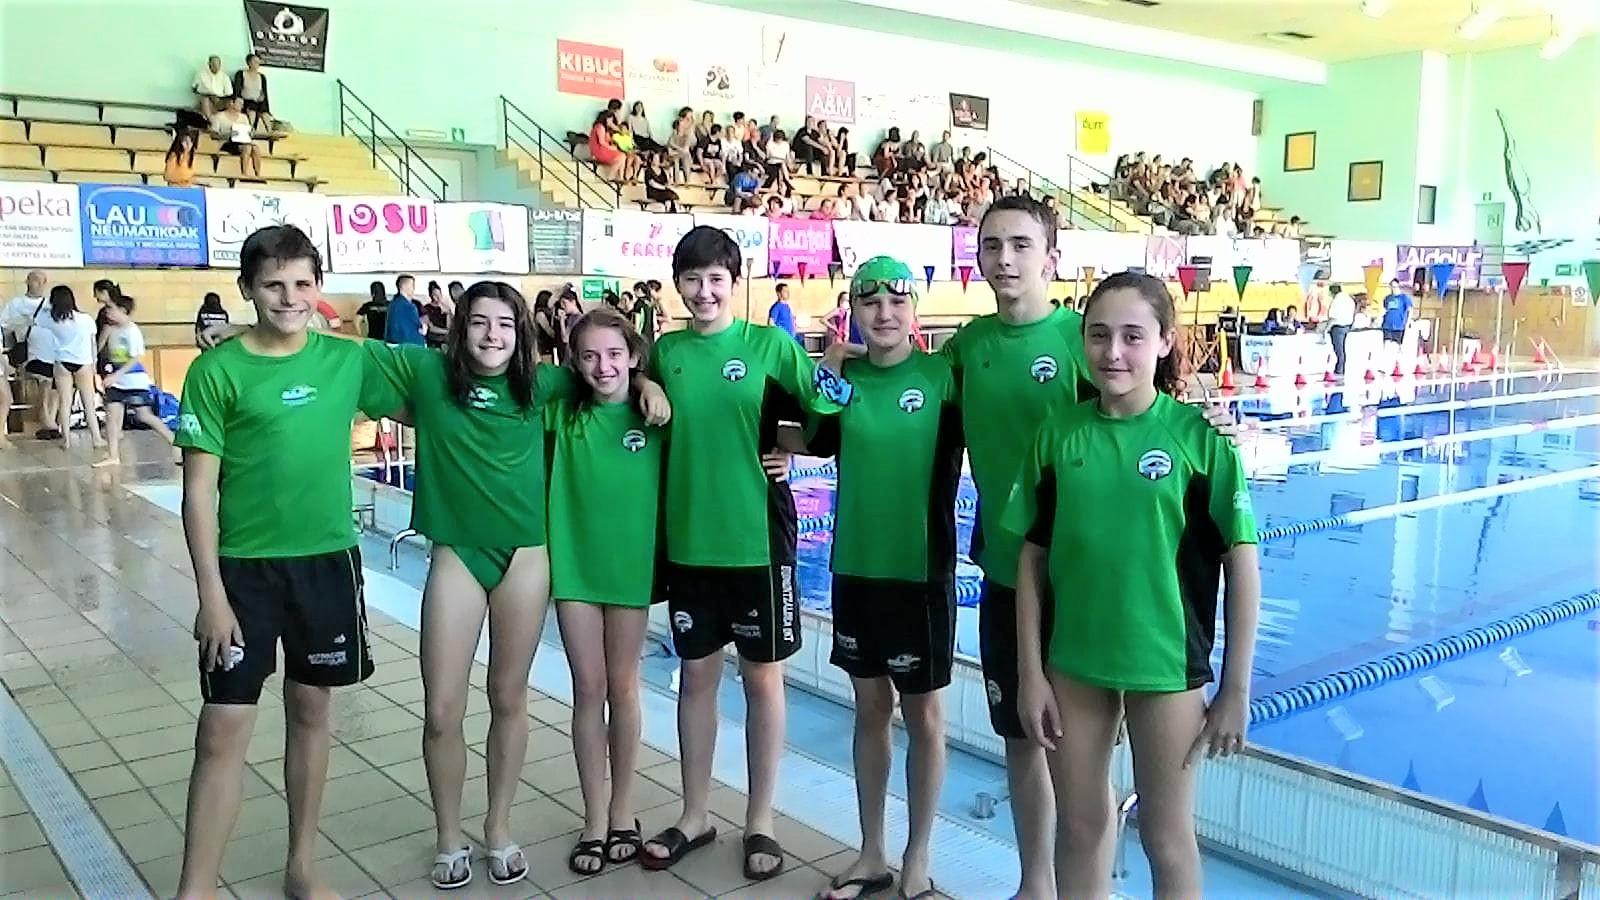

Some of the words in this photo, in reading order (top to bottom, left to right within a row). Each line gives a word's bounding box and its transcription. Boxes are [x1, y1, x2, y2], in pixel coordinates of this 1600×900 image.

[559, 52, 622, 79] KIBUC
[810, 92, 853, 118] A&M
[89, 203, 147, 225] LAU
[333, 203, 428, 234] IOSU
[91, 224, 199, 239] NEUMATIKOAK
[336, 239, 430, 256] OPTKA
